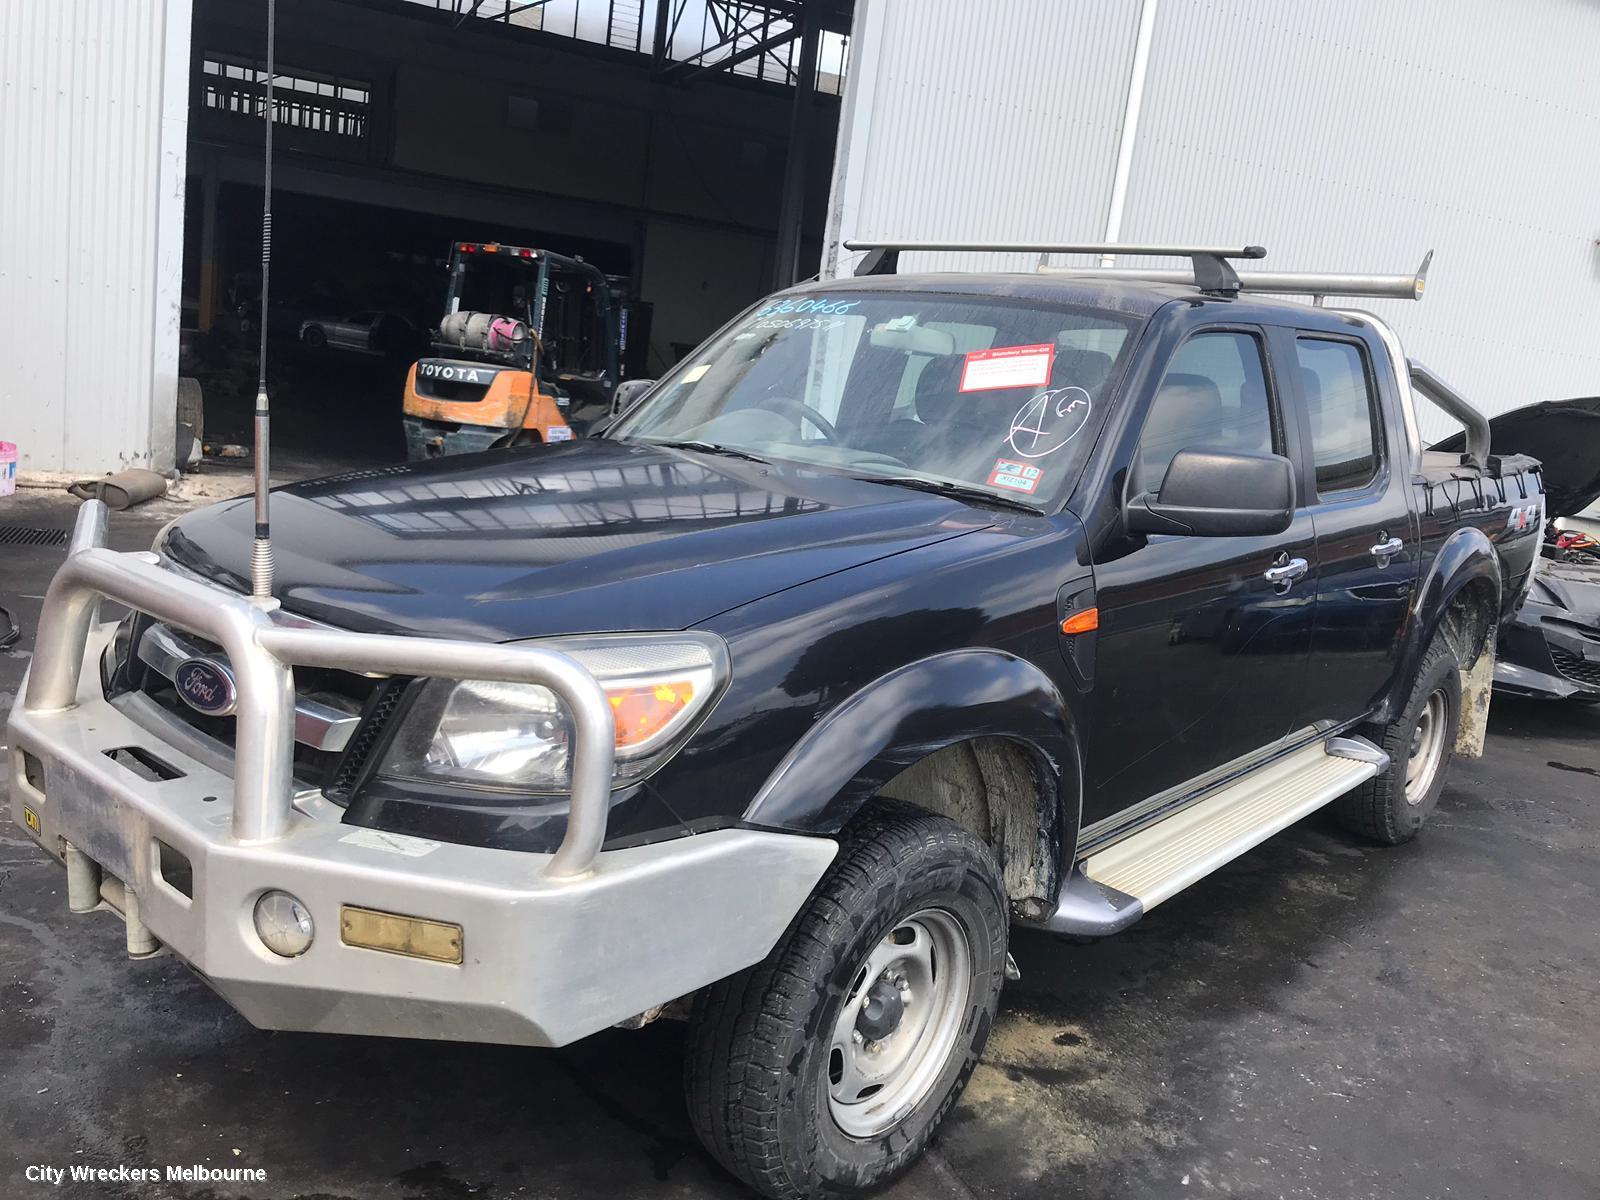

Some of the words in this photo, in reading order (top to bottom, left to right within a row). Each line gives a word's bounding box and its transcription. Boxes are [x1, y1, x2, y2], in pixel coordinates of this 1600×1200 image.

[420, 363, 479, 382] TOYOTA
[1003, 394, 1051, 449] A
[184, 667, 218, 702] Ford
